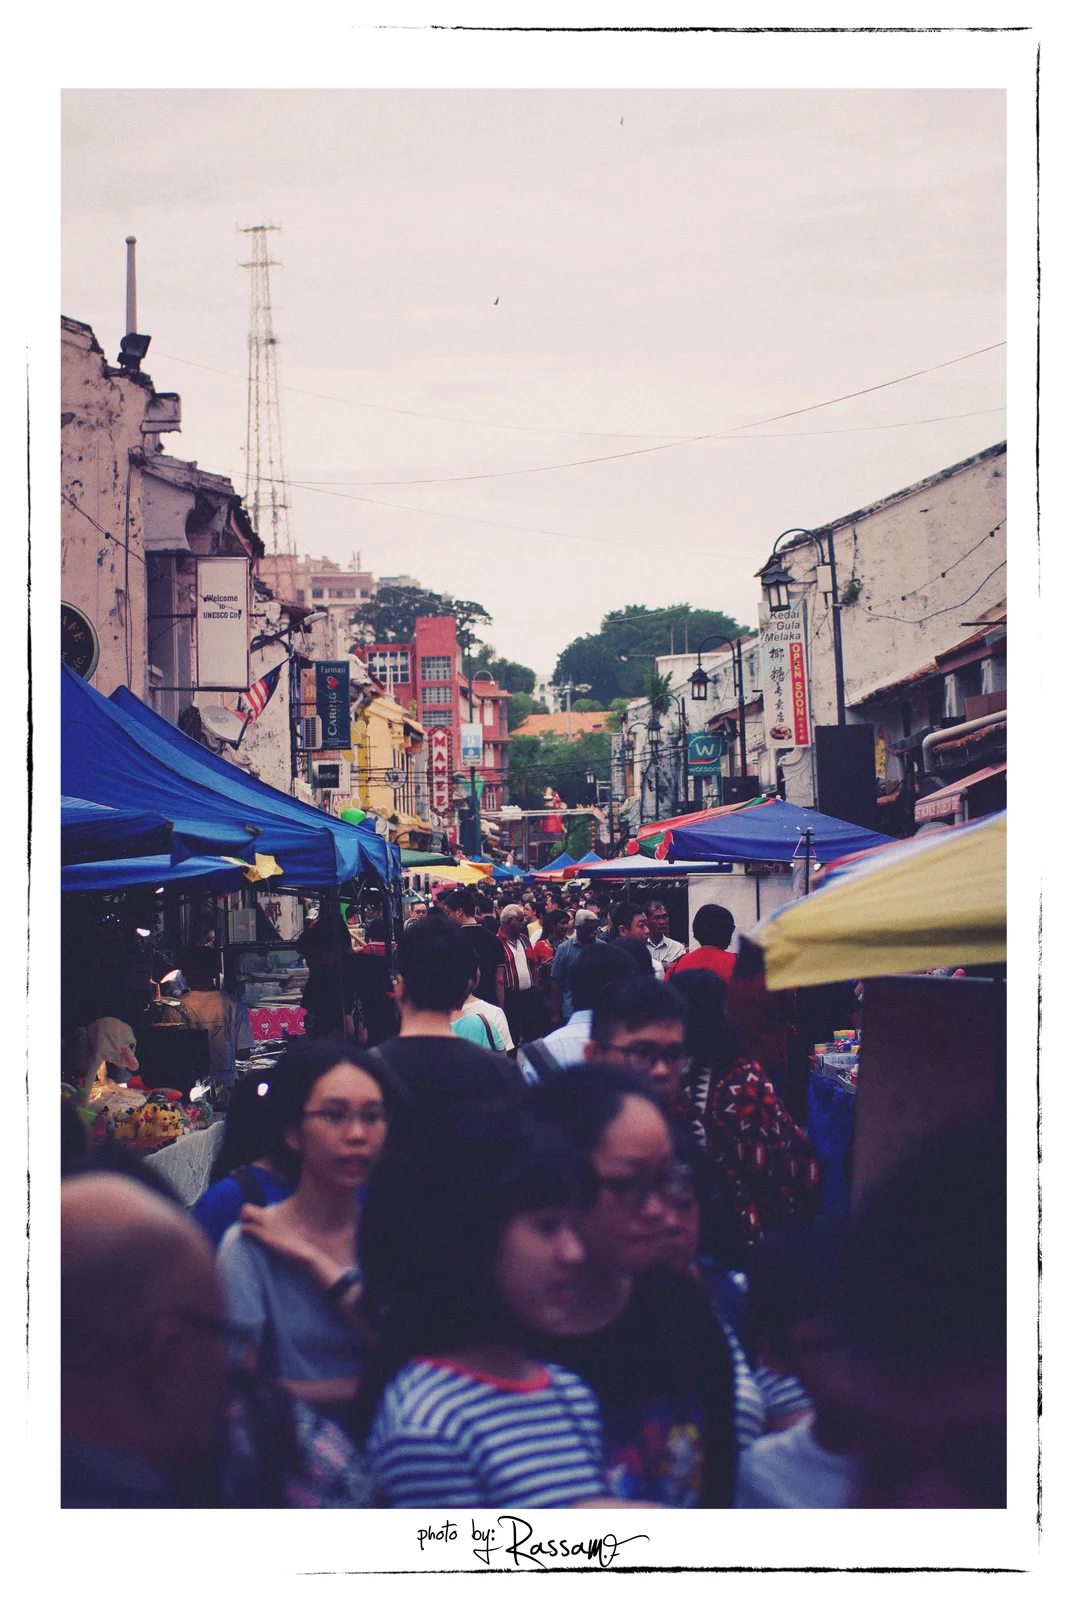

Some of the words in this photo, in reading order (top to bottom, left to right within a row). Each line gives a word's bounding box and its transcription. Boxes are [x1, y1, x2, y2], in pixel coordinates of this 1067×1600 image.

[770, 611, 800, 619] Kedai
[776, 621, 800, 630] Gula
[765, 632, 801, 642] Melaka
[792, 644, 802, 679] OPEN
[321, 666, 346, 674] Farmasi
[795, 681, 804, 716] SOON
[434, 736, 446, 806] MAMEE
